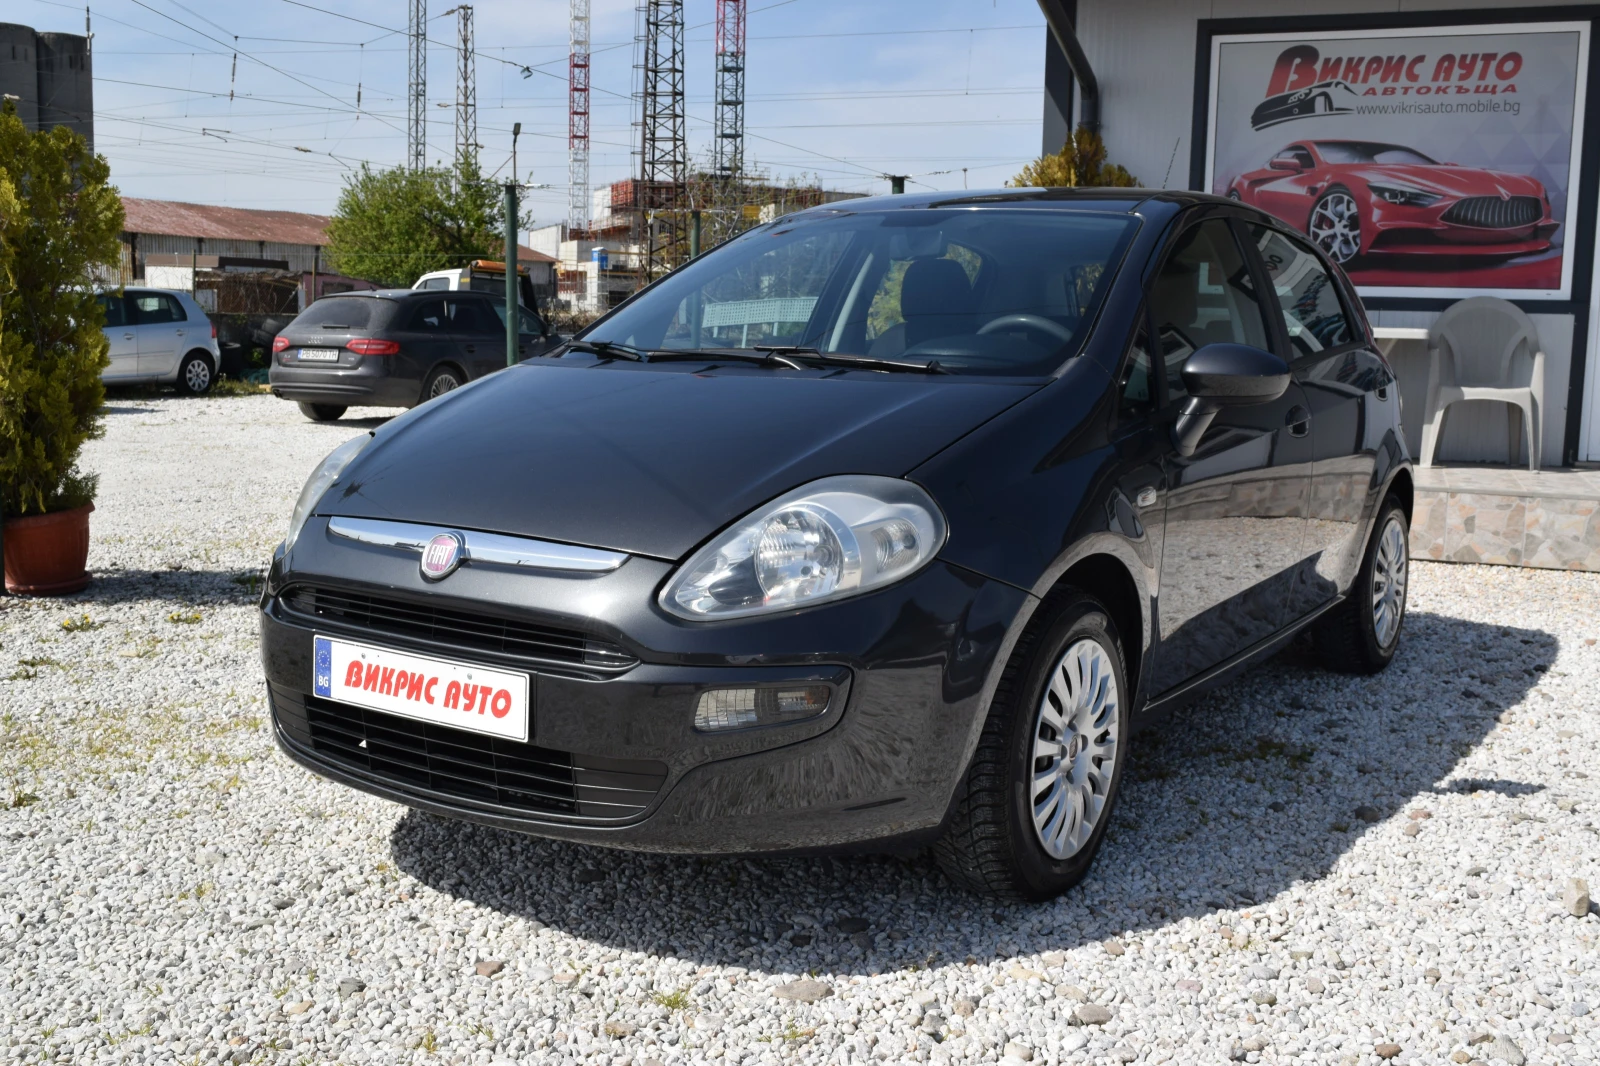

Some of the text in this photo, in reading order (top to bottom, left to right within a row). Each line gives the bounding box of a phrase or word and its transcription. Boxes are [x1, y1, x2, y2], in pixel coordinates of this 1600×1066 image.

[1431, 51, 1523, 82] АУТО
[1362, 84, 1517, 96] АВТОКЪЩА
[1356, 99, 1521, 115] www.vikrisauto.mobile.bg
[427, 544, 452, 566] FIAT
[318, 675, 329, 687] BG
[344, 660, 512, 718] ВИКРИС АУТО
